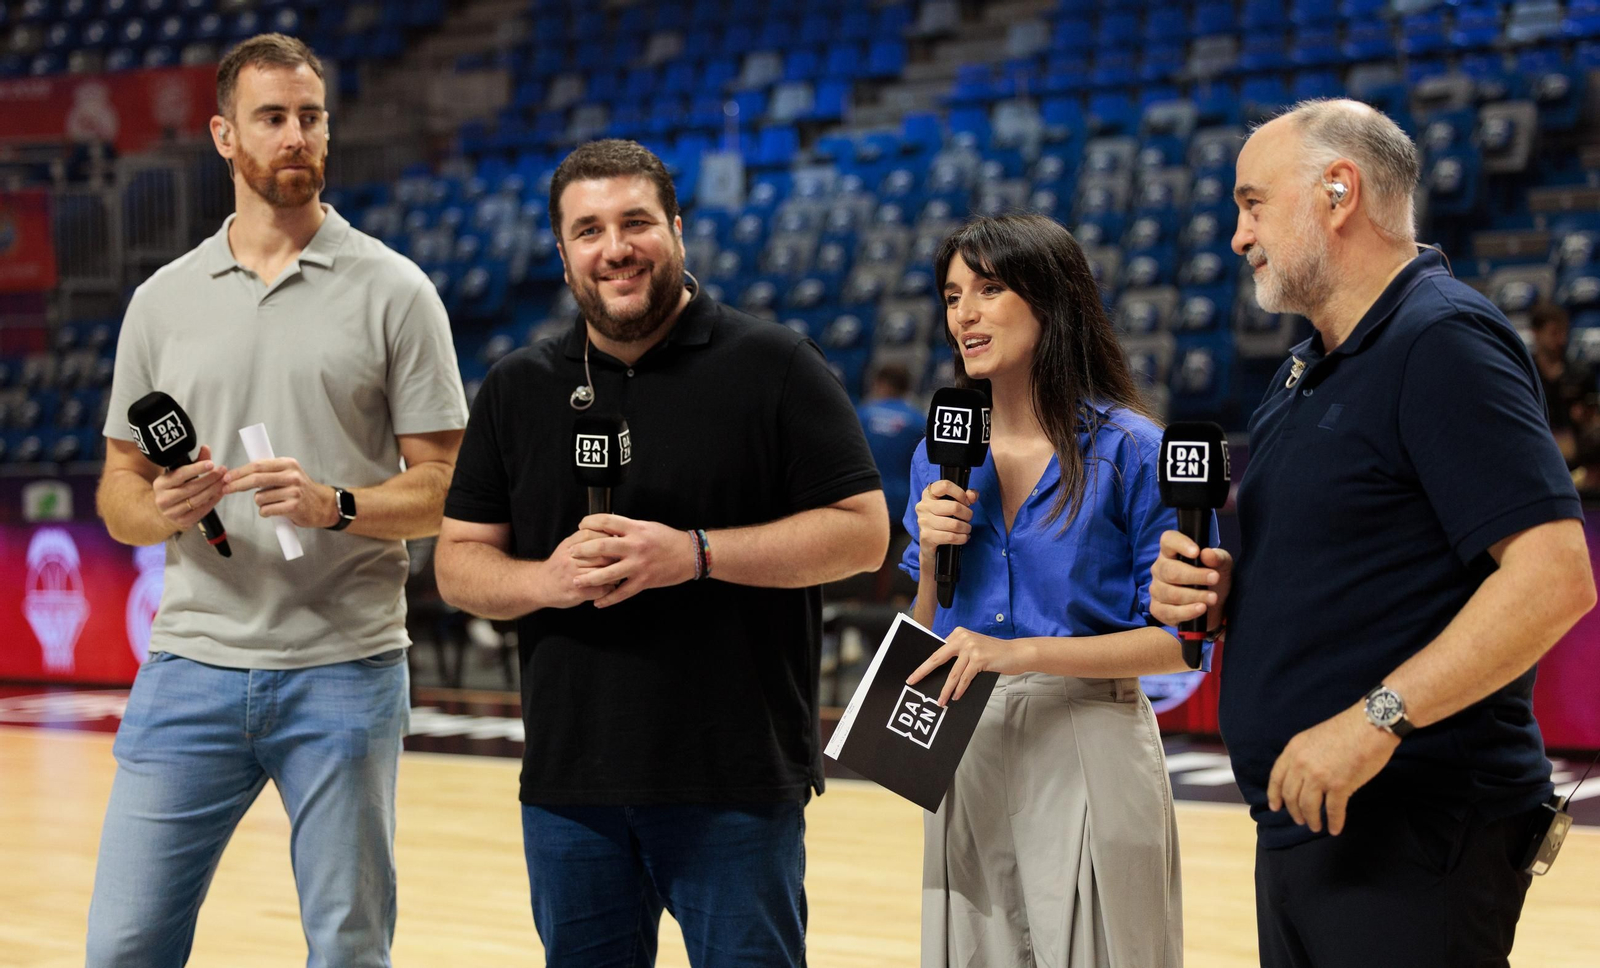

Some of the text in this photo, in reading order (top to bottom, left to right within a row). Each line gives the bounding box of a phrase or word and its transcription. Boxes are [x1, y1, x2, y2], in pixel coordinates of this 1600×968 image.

[943, 412, 963, 425] DA
[157, 419, 176, 435] DA
[942, 425, 962, 438] ZN
[162, 427, 180, 444] ZN
[582, 439, 601, 451] DA
[582, 451, 601, 463] ZN
[1176, 447, 1200, 461] DA
[1176, 461, 1199, 476] ZN
[898, 701, 921, 727] DA
[913, 707, 937, 736] ZN
